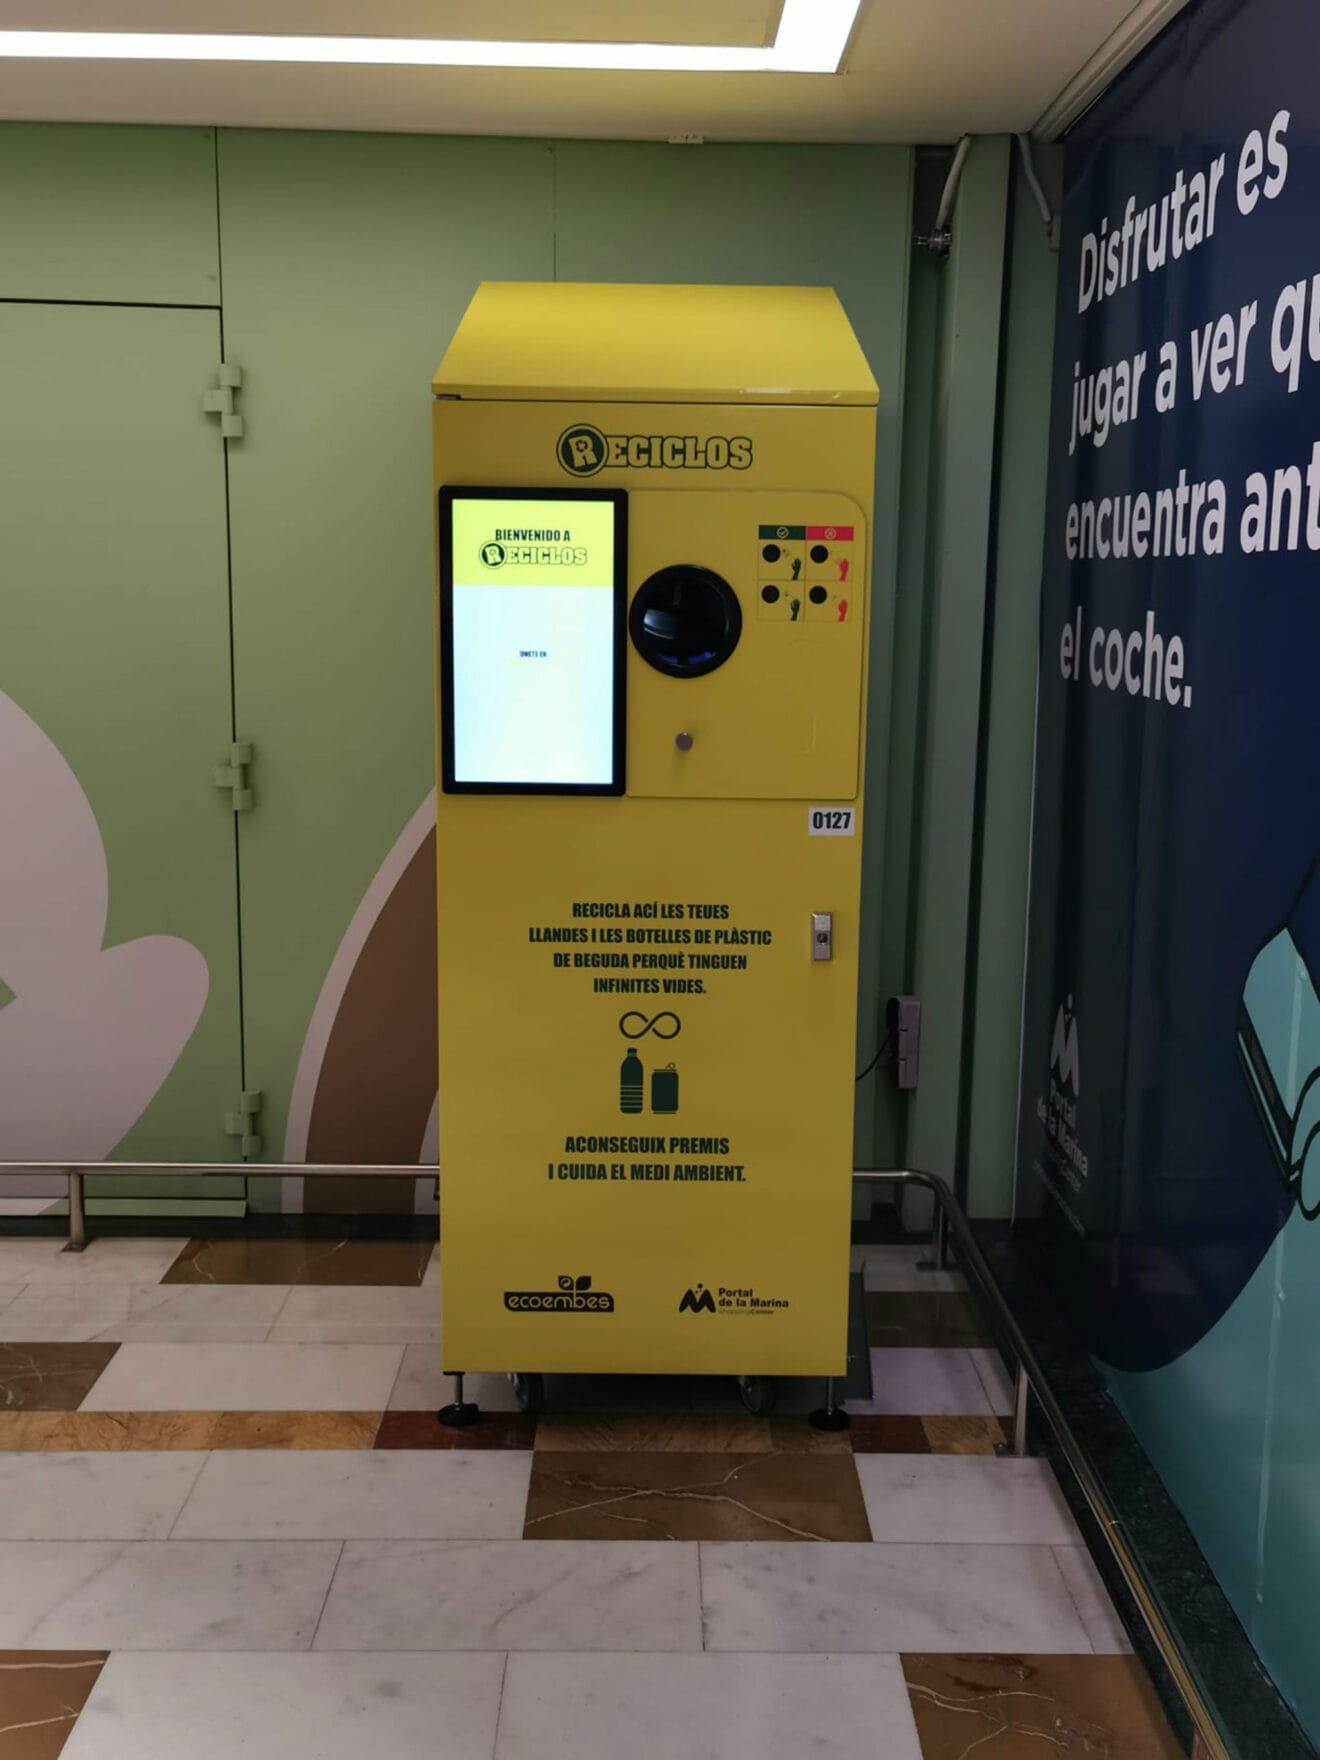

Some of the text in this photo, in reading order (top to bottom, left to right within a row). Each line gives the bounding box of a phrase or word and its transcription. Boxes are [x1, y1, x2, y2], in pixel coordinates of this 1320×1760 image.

[1078, 110, 1291, 314] Disfrutar es
[1069, 351, 1147, 456] jugar
[1155, 341, 1177, 413] a
[1190, 300, 1258, 400] ver
[556, 423, 753, 478] RECICLOS
[1065, 469, 1226, 560] encuentra
[495, 529, 571, 541] BIENVENIDO A
[480, 540, 587, 570] RECICLOS
[1060, 605, 1192, 708] el coche.
[812, 811, 852, 830] 0127
[572, 901, 730, 920] RECICLA ACÍ LES TEUES
[528, 927, 772, 946] LLANDES I LES BOTELLES DE PLÀSTIC
[553, 951, 748, 971] DE BEGUDA PERQUÈ TINGUEN
[593, 978, 707, 995] INFINITES VIDES.
[564, 1136, 730, 1155] ACONSEGUIX PREMIS
[548, 1163, 747, 1182] I CUIDA EL MEDI AMBIENT.
[507, 1293, 611, 1310] ecoembes
[718, 1287, 753, 1298] Portal
[718, 1298, 790, 1308] de la Marina
